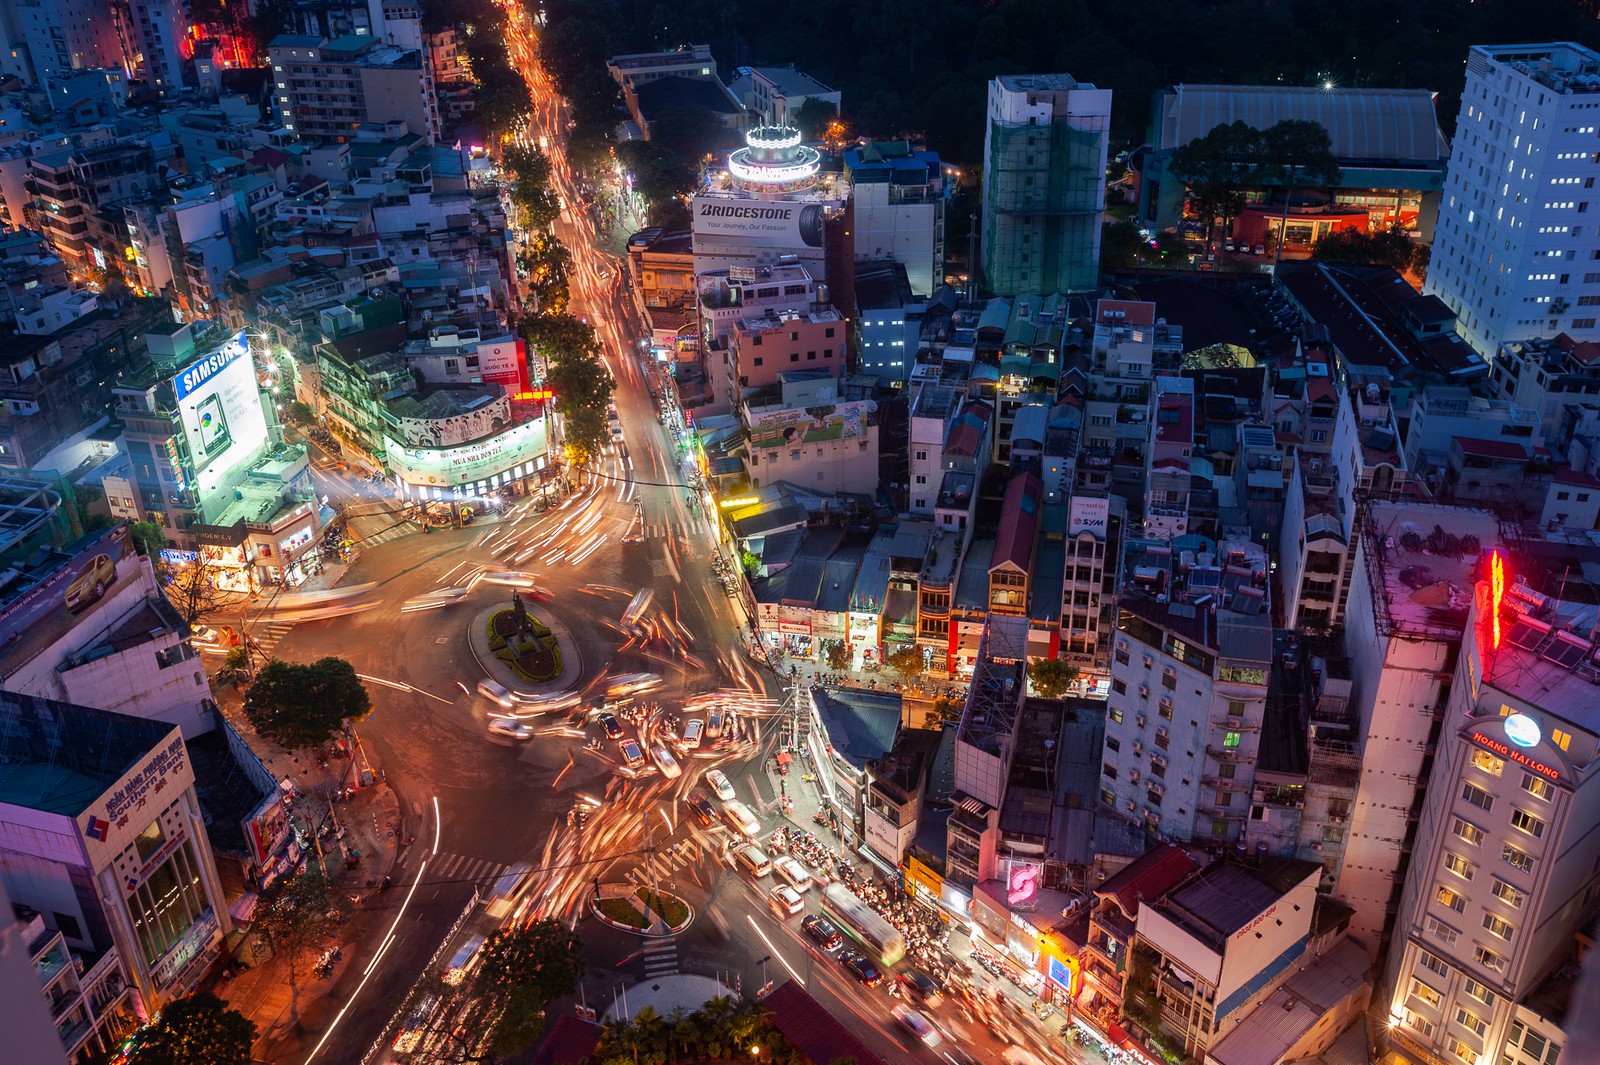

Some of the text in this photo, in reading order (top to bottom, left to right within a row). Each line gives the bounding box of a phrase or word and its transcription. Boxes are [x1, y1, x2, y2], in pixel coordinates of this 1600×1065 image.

[701, 204, 792, 220] BRIDGESTONE
[722, 223, 748, 231] Journey,
[1082, 518, 1104, 527] SYM
[168, 736, 183, 754] NAM
[1529, 760, 1559, 779] LONG
[109, 750, 184, 822] Southern Bank
